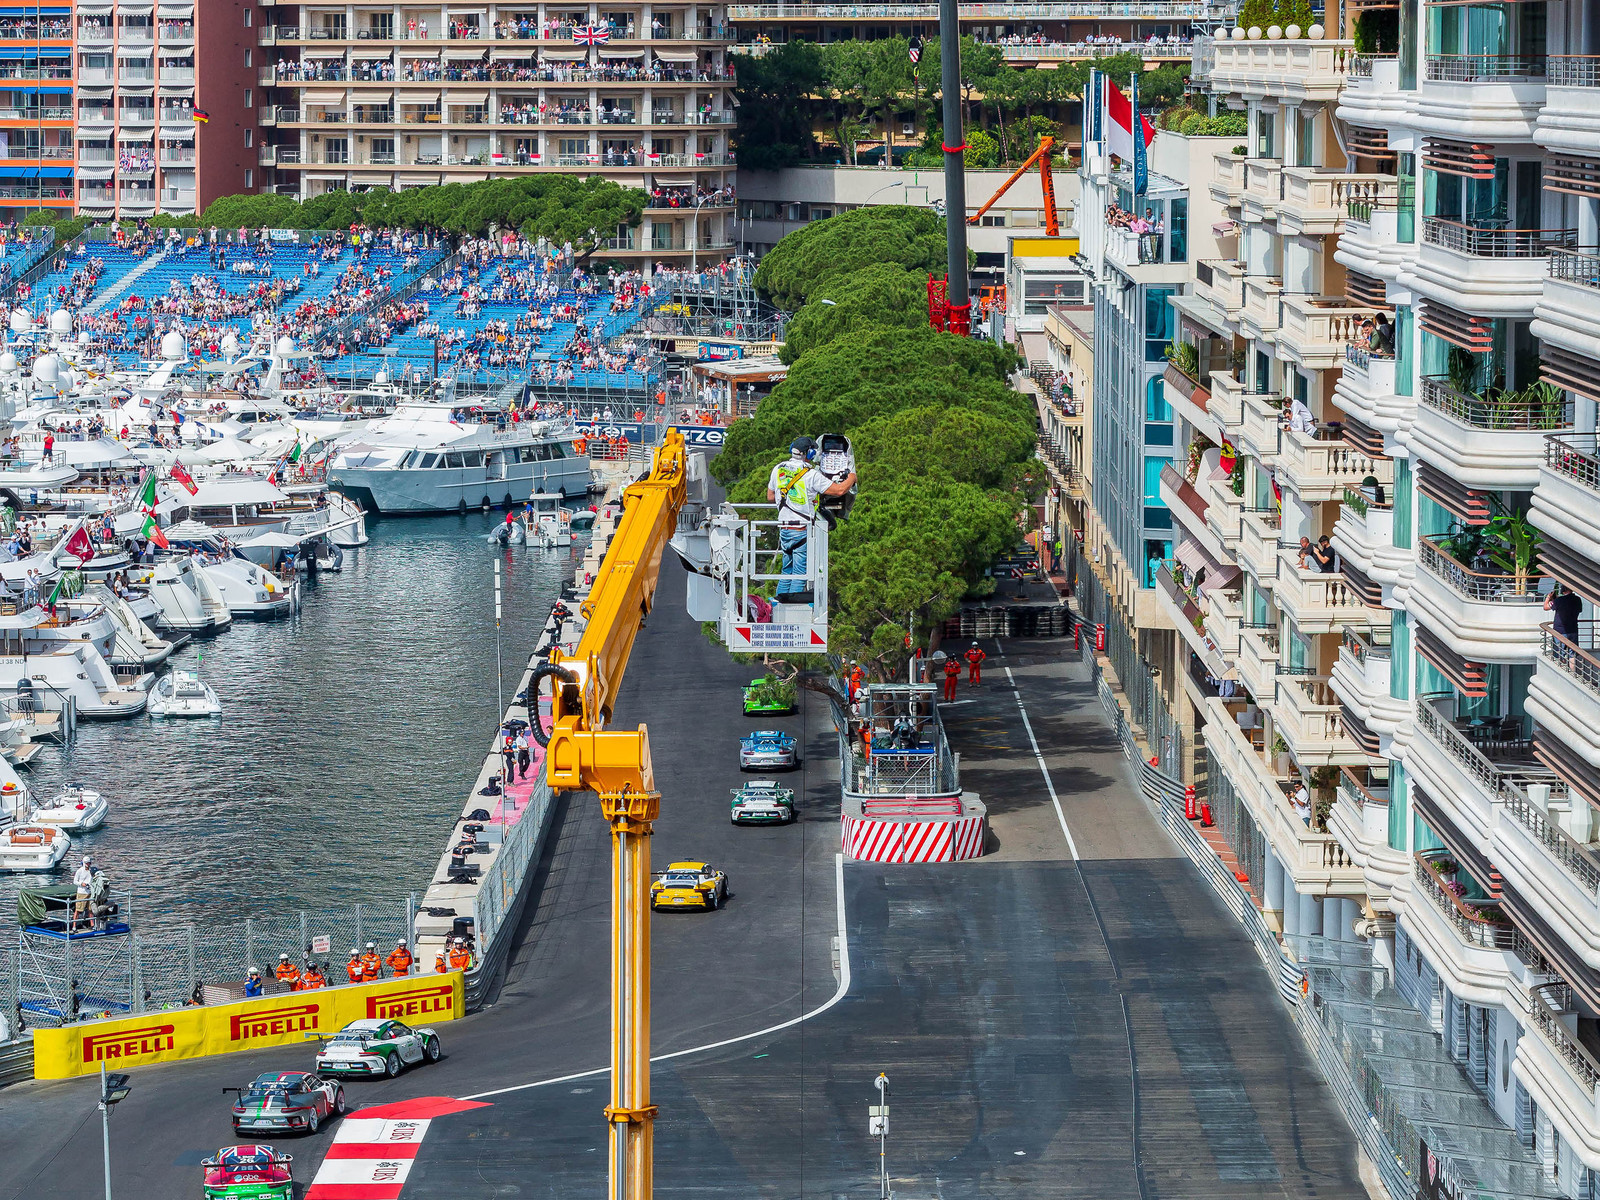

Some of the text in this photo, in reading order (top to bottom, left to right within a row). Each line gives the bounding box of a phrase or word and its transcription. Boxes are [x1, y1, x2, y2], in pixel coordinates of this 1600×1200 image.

[366, 985, 453, 1020] PIRELLI
[230, 1004, 320, 1041] PIRELLI
[83, 1024, 175, 1063] PIRELLI
[389, 1128, 416, 1141] UBS
[371, 1167, 399, 1181] UBS
